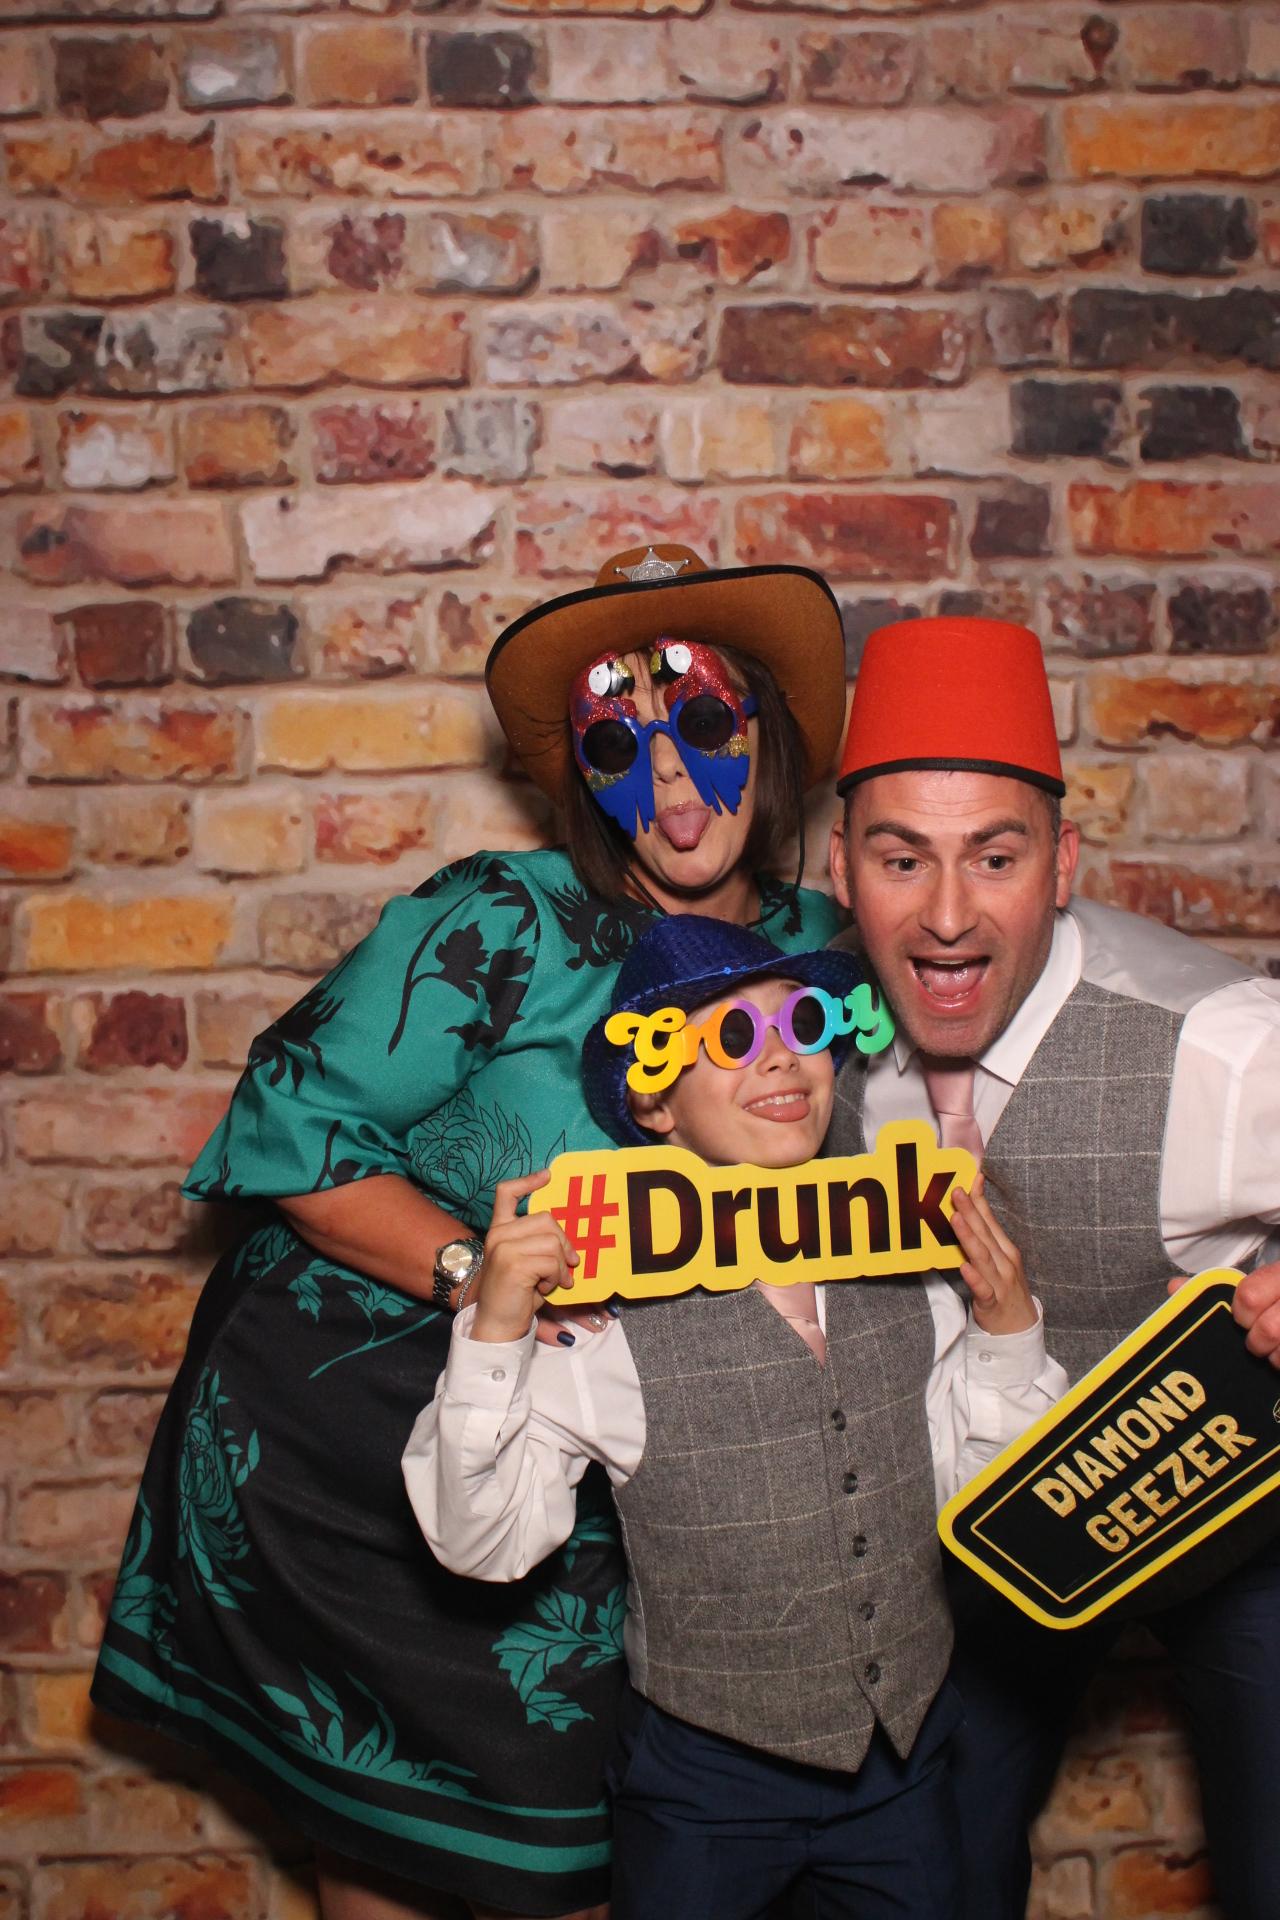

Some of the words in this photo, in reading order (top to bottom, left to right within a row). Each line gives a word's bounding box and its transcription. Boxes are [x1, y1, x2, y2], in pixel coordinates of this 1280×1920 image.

[551, 1143, 960, 1279] #Drunk
[1032, 1370, 1206, 1518] DIAMOND
[1085, 1414, 1257, 1552] GEEZER
